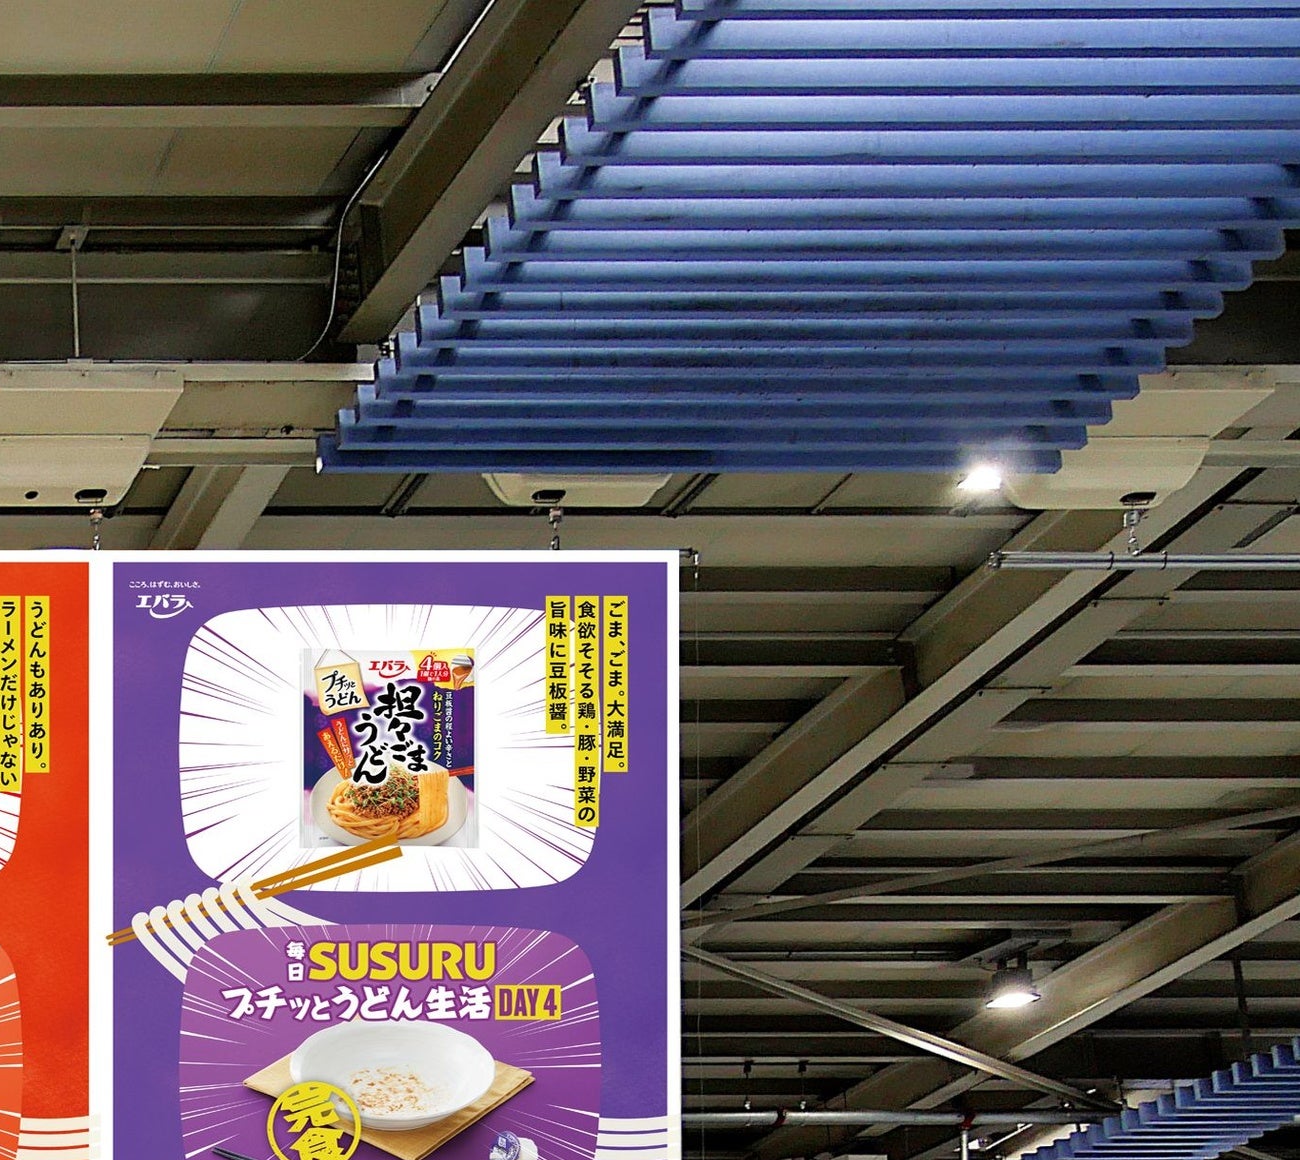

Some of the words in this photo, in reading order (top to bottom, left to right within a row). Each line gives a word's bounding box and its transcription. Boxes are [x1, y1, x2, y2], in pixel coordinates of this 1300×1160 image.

[129, 581, 200, 589] こころ、はずむ、おいしさ。
[136, 595, 193, 619] エバラ
[0, 601, 18, 787] ラーメンだけじゃない
[30, 601, 46, 770] うどんもありあり。
[322, 670, 355, 692] プチッと
[325, 692, 361, 708] うどん
[549, 601, 567, 731] 旨味に豆板醤。
[606, 601, 626, 769] ごま、ごま。大満足。
[374, 683, 428, 772] 担々ごま
[432, 692, 443, 761] ねりごまのコク
[578, 601, 596, 823] 食欲そそる鶏・豚・野菜の
[353, 713, 388, 783] うどん
[287, 941, 305, 982] 毎日
[308, 942, 496, 980] SUSURU
[221, 985, 491, 1021] プチッとうどん生活
[500, 988, 538, 1017] DAY
[542, 988, 557, 1017] 4
